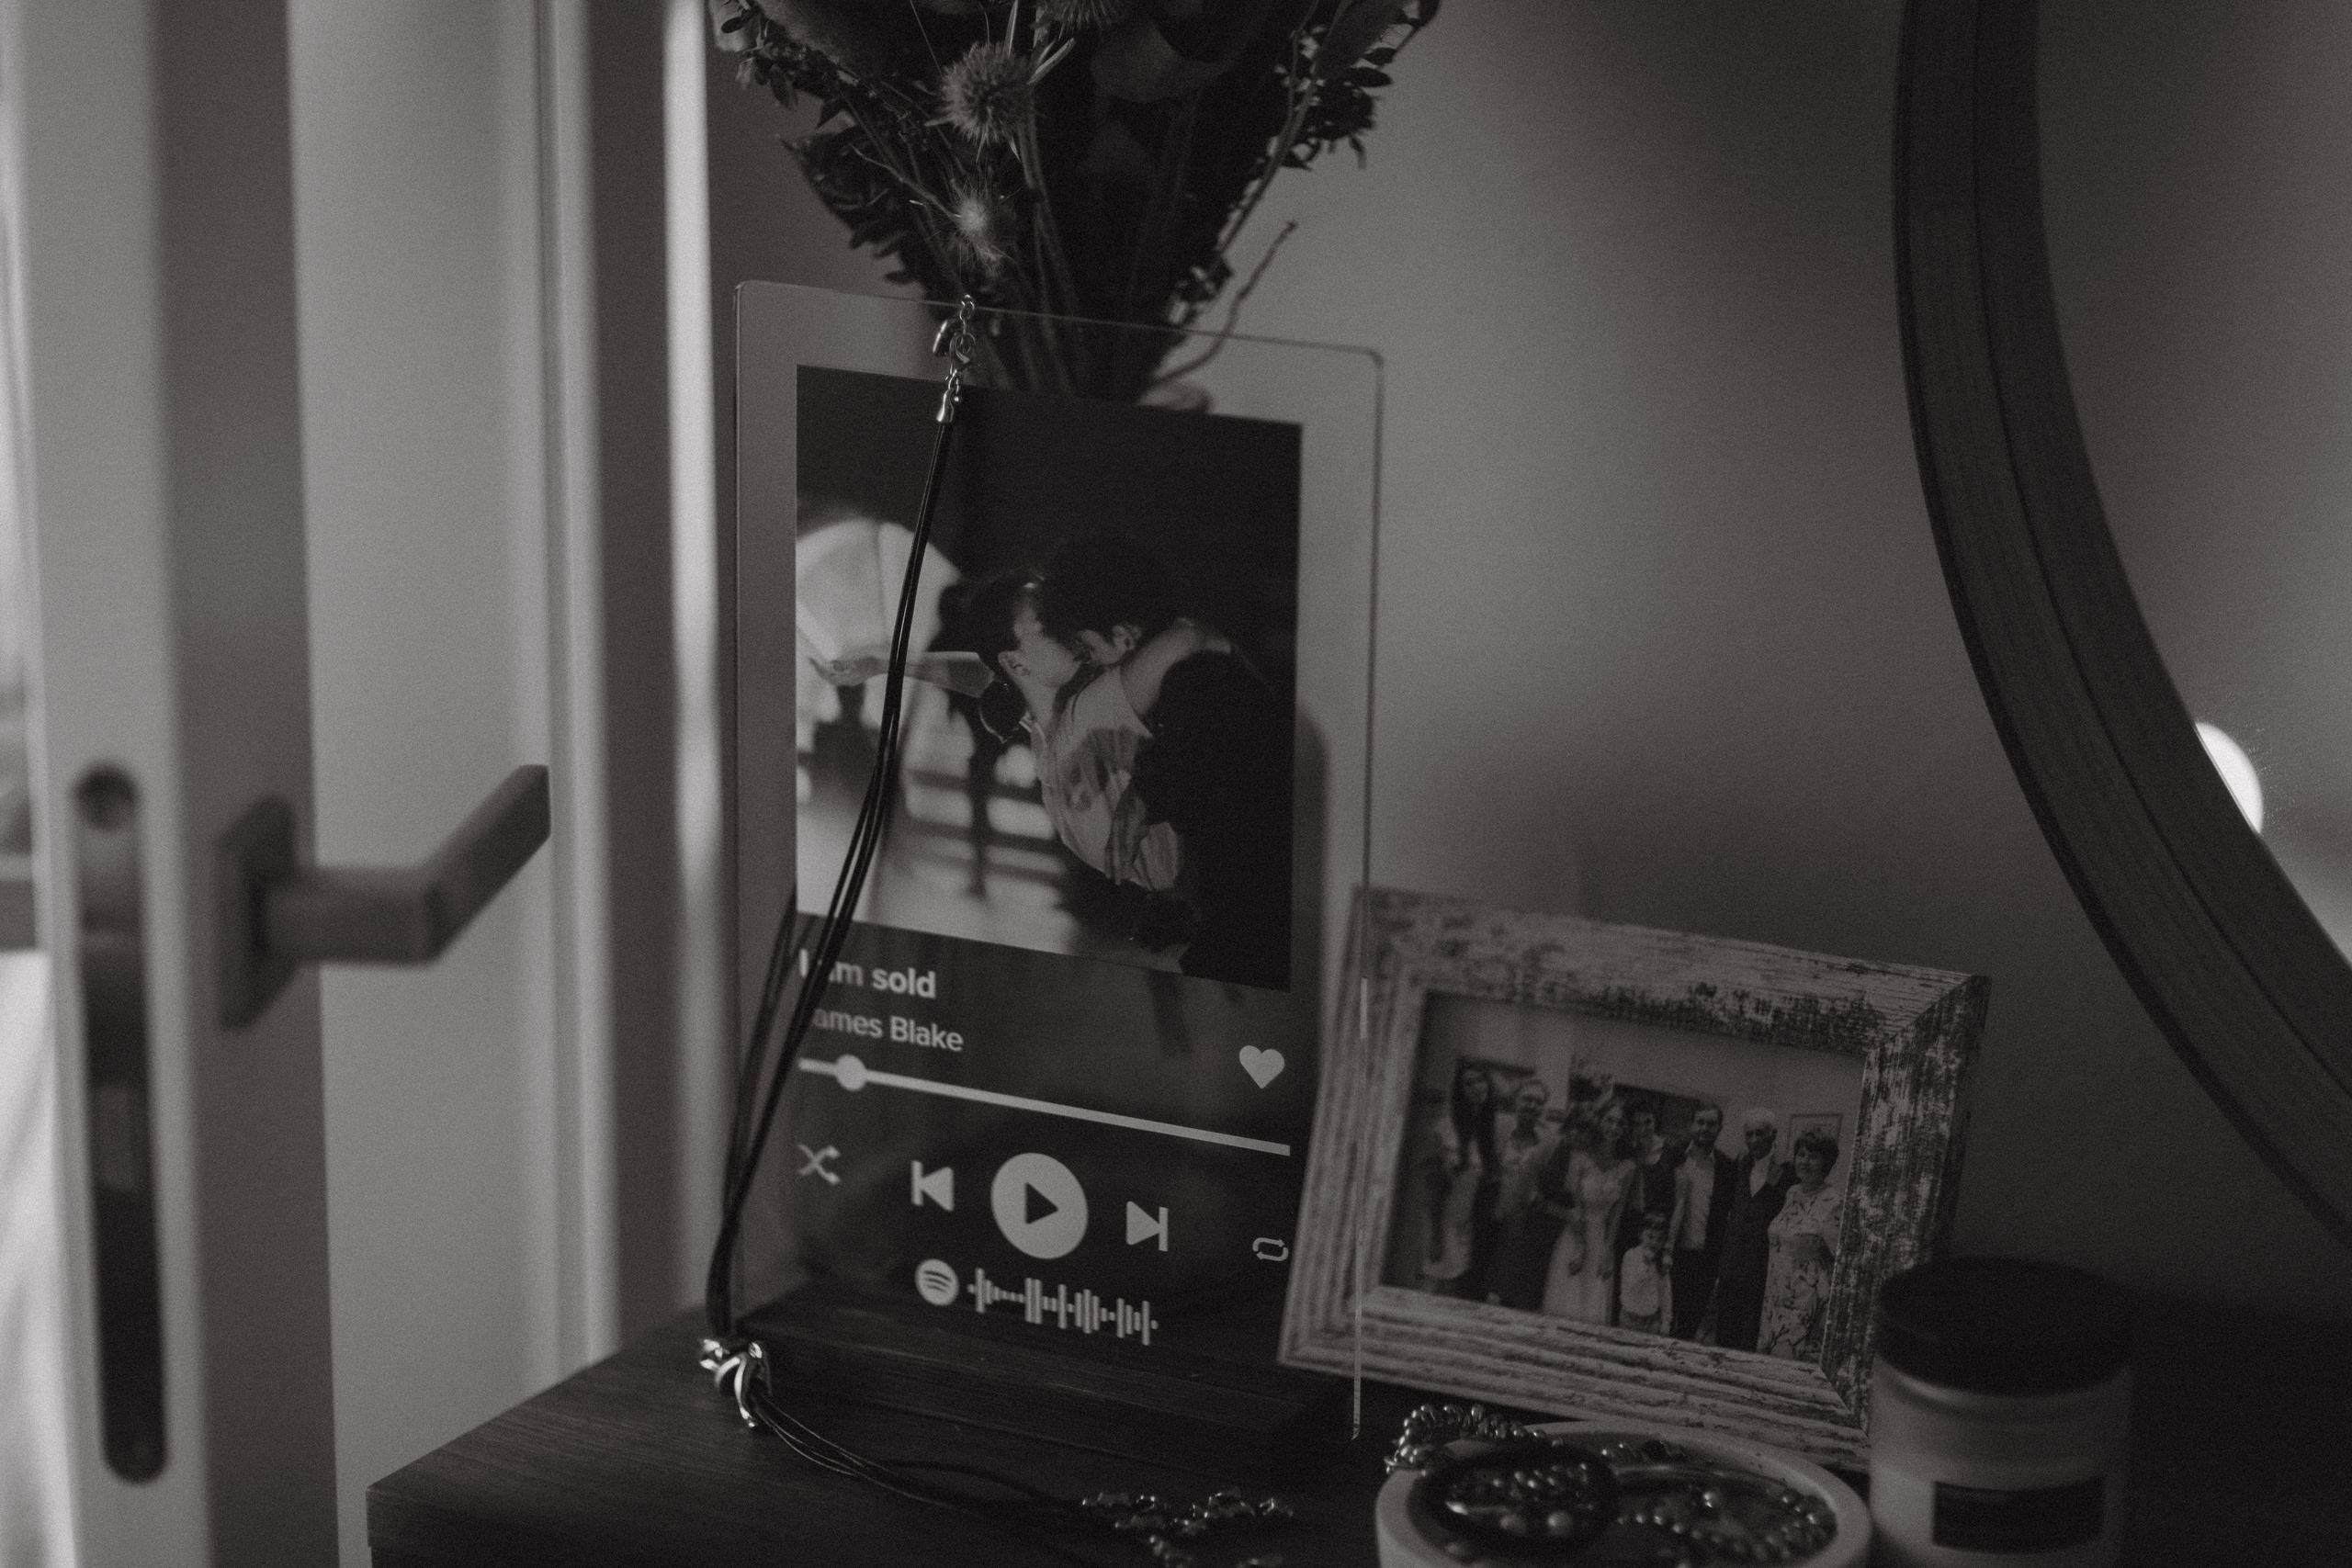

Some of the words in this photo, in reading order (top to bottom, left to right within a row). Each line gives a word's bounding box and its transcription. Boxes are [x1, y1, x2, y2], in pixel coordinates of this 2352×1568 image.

[798, 949, 808, 978] I
[818, 957, 865, 987] m
[871, 967, 936, 998] sold
[808, 1009, 883, 1039] ames
[889, 1015, 964, 1052] Blake
